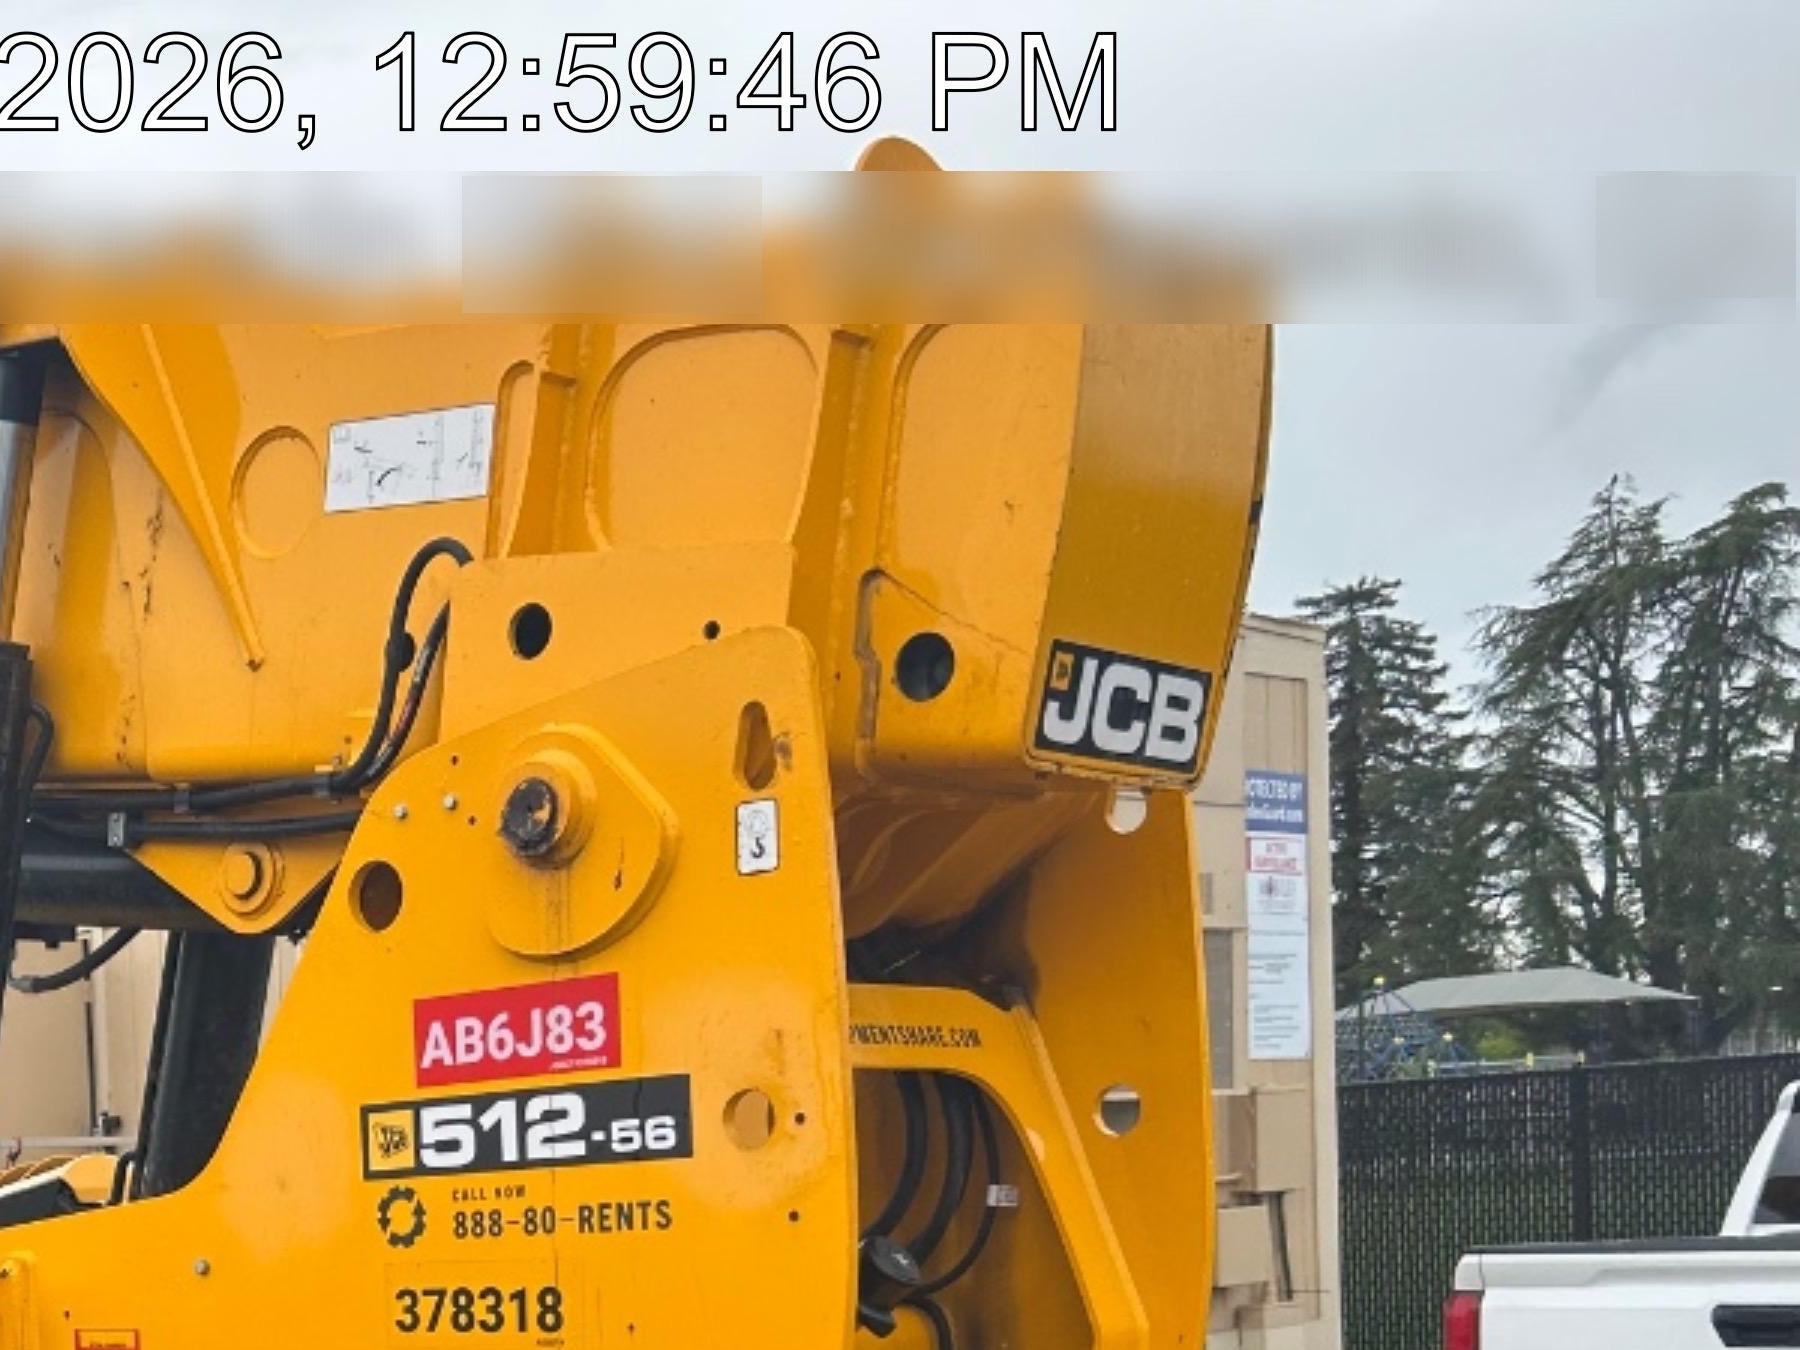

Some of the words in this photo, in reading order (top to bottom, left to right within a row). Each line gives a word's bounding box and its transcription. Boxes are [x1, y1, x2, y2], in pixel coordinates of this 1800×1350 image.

[1043, 656, 1204, 763] JCB
[419, 1000, 607, 1069] AB6J83
[451, 1186, 487, 1203] CALL
[494, 1184, 526, 1200] NOW
[452, 1200, 673, 1240] 888-80-RENTS
[394, 1286, 565, 1333] 378318
